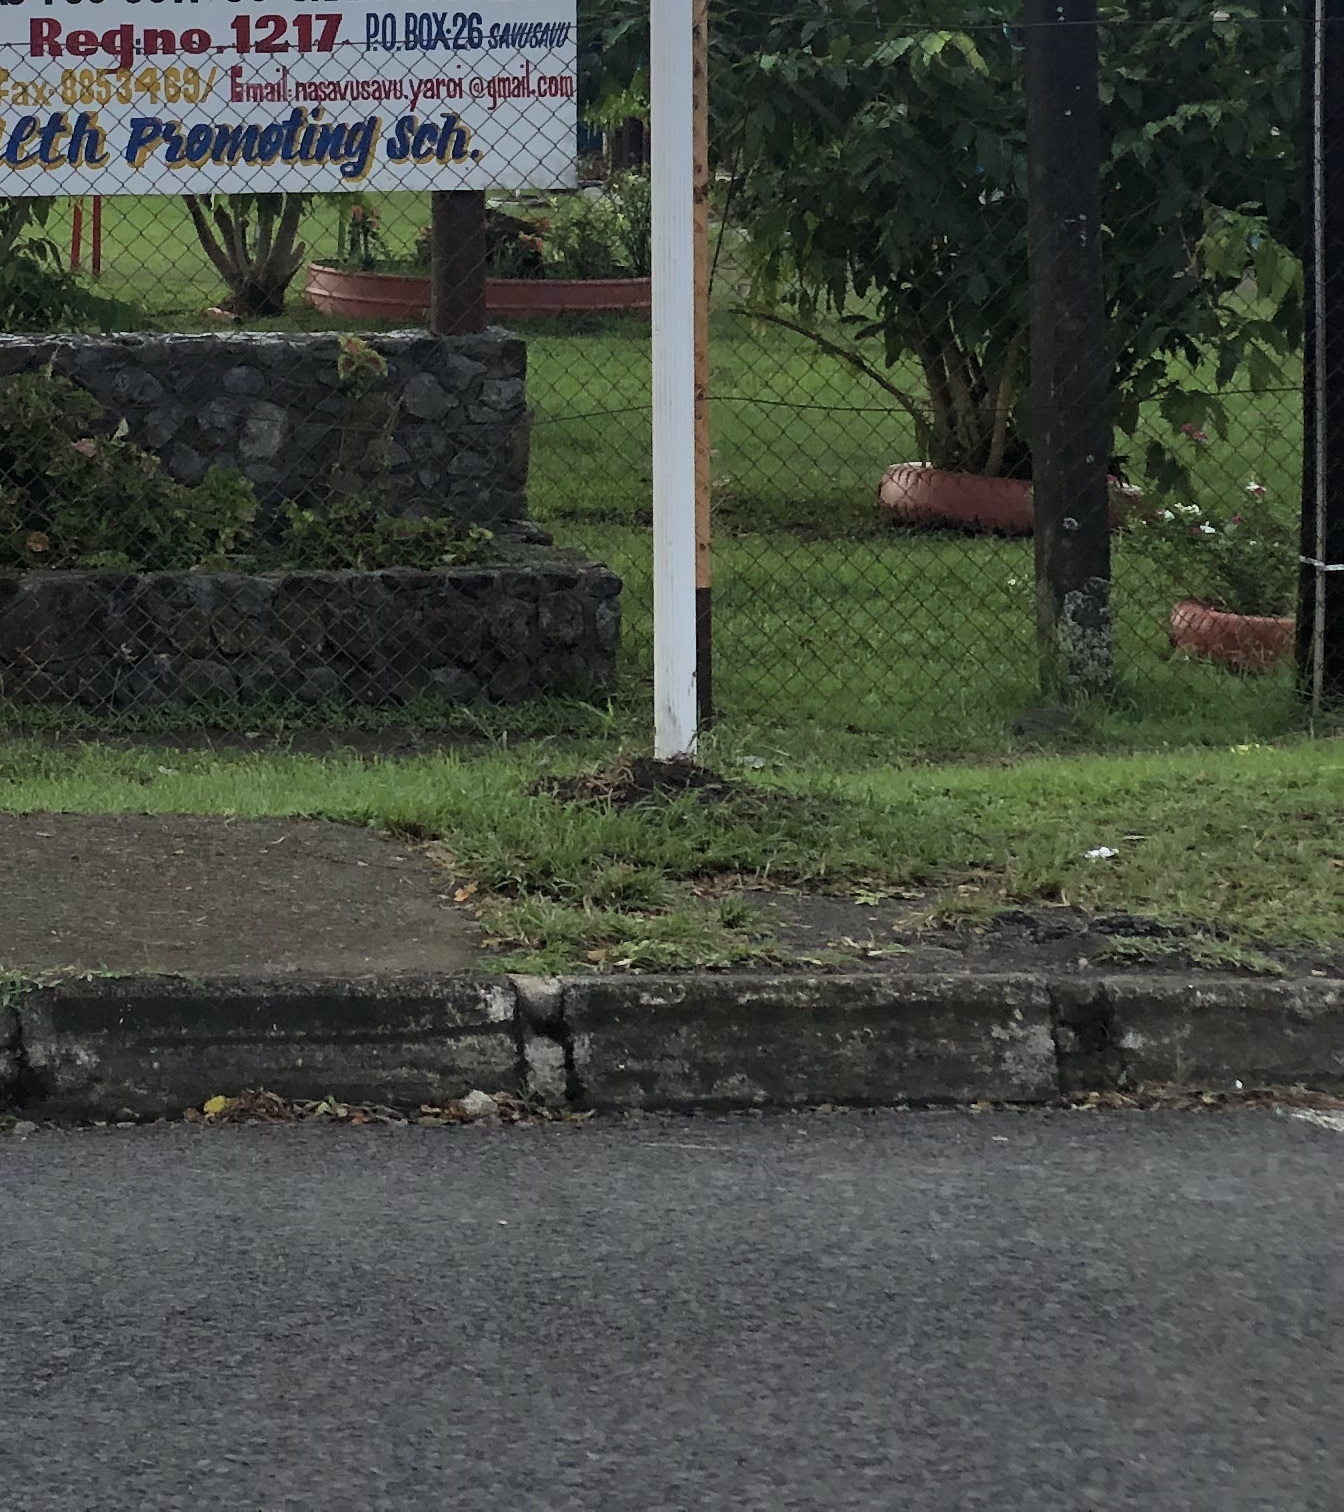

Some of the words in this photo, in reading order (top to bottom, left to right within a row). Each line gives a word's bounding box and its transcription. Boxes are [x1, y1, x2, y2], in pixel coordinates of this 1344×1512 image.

[487, 21, 572, 51] SAVUSAVU
[124, 105, 385, 183] Promoting
[386, 110, 485, 166] Sch.
